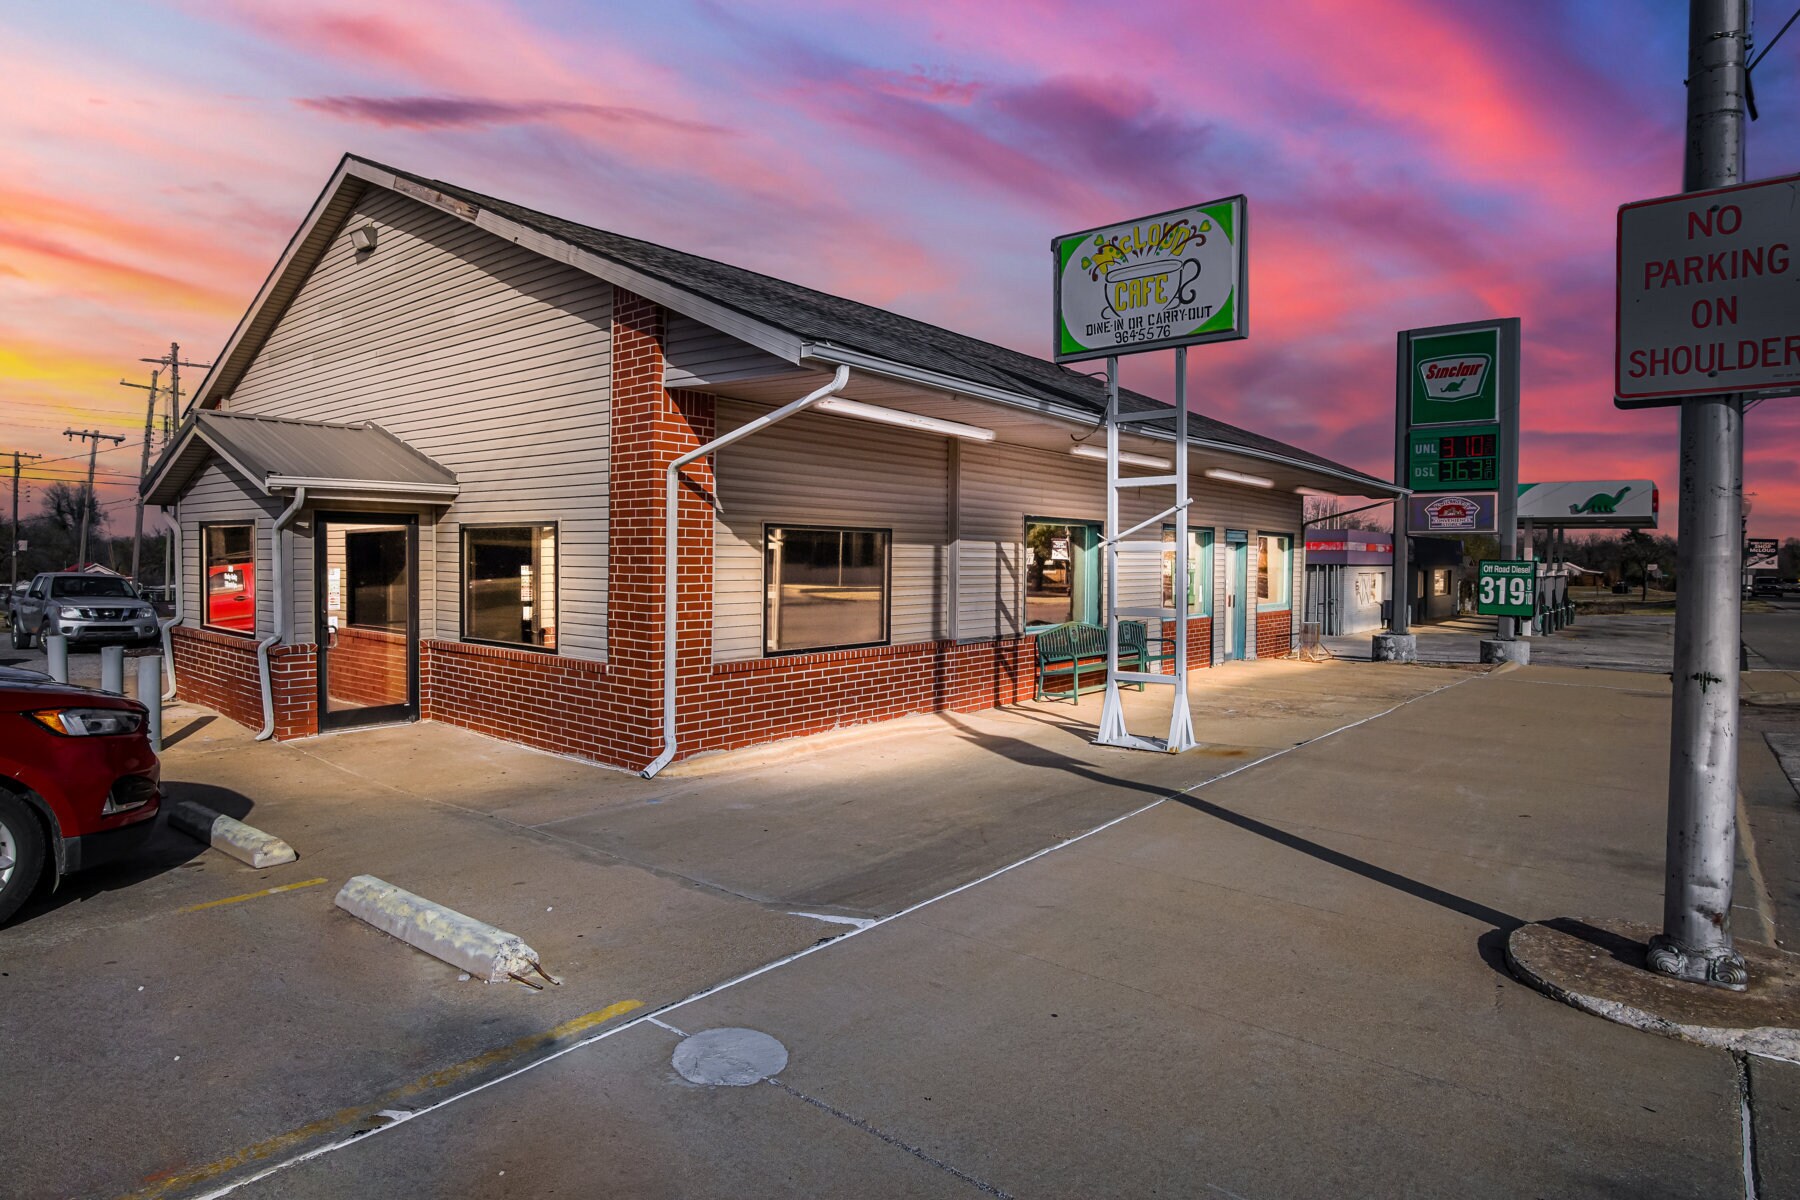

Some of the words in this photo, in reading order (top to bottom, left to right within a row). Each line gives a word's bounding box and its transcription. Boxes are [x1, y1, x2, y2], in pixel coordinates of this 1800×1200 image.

[1688, 205, 1742, 240] NO
[1644, 243, 1790, 290] PARKING
[1114, 274, 1169, 312] CAFE
[1086, 317, 1124, 337] DINE-IN
[1128, 316, 1143, 330] OR
[1147, 305, 1213, 327] CARRY-OUT
[1692, 295, 1737, 329] ON
[1426, 362, 1484, 380] Sinclair
[1415, 443, 1437, 454] UNL
[1414, 467, 1435, 477] DSL
[1483, 564, 1493, 573] Off
[1494, 565, 1510, 573] Road
[1511, 565, 1531, 574] Diesel
[1480, 576, 1525, 605] 319
